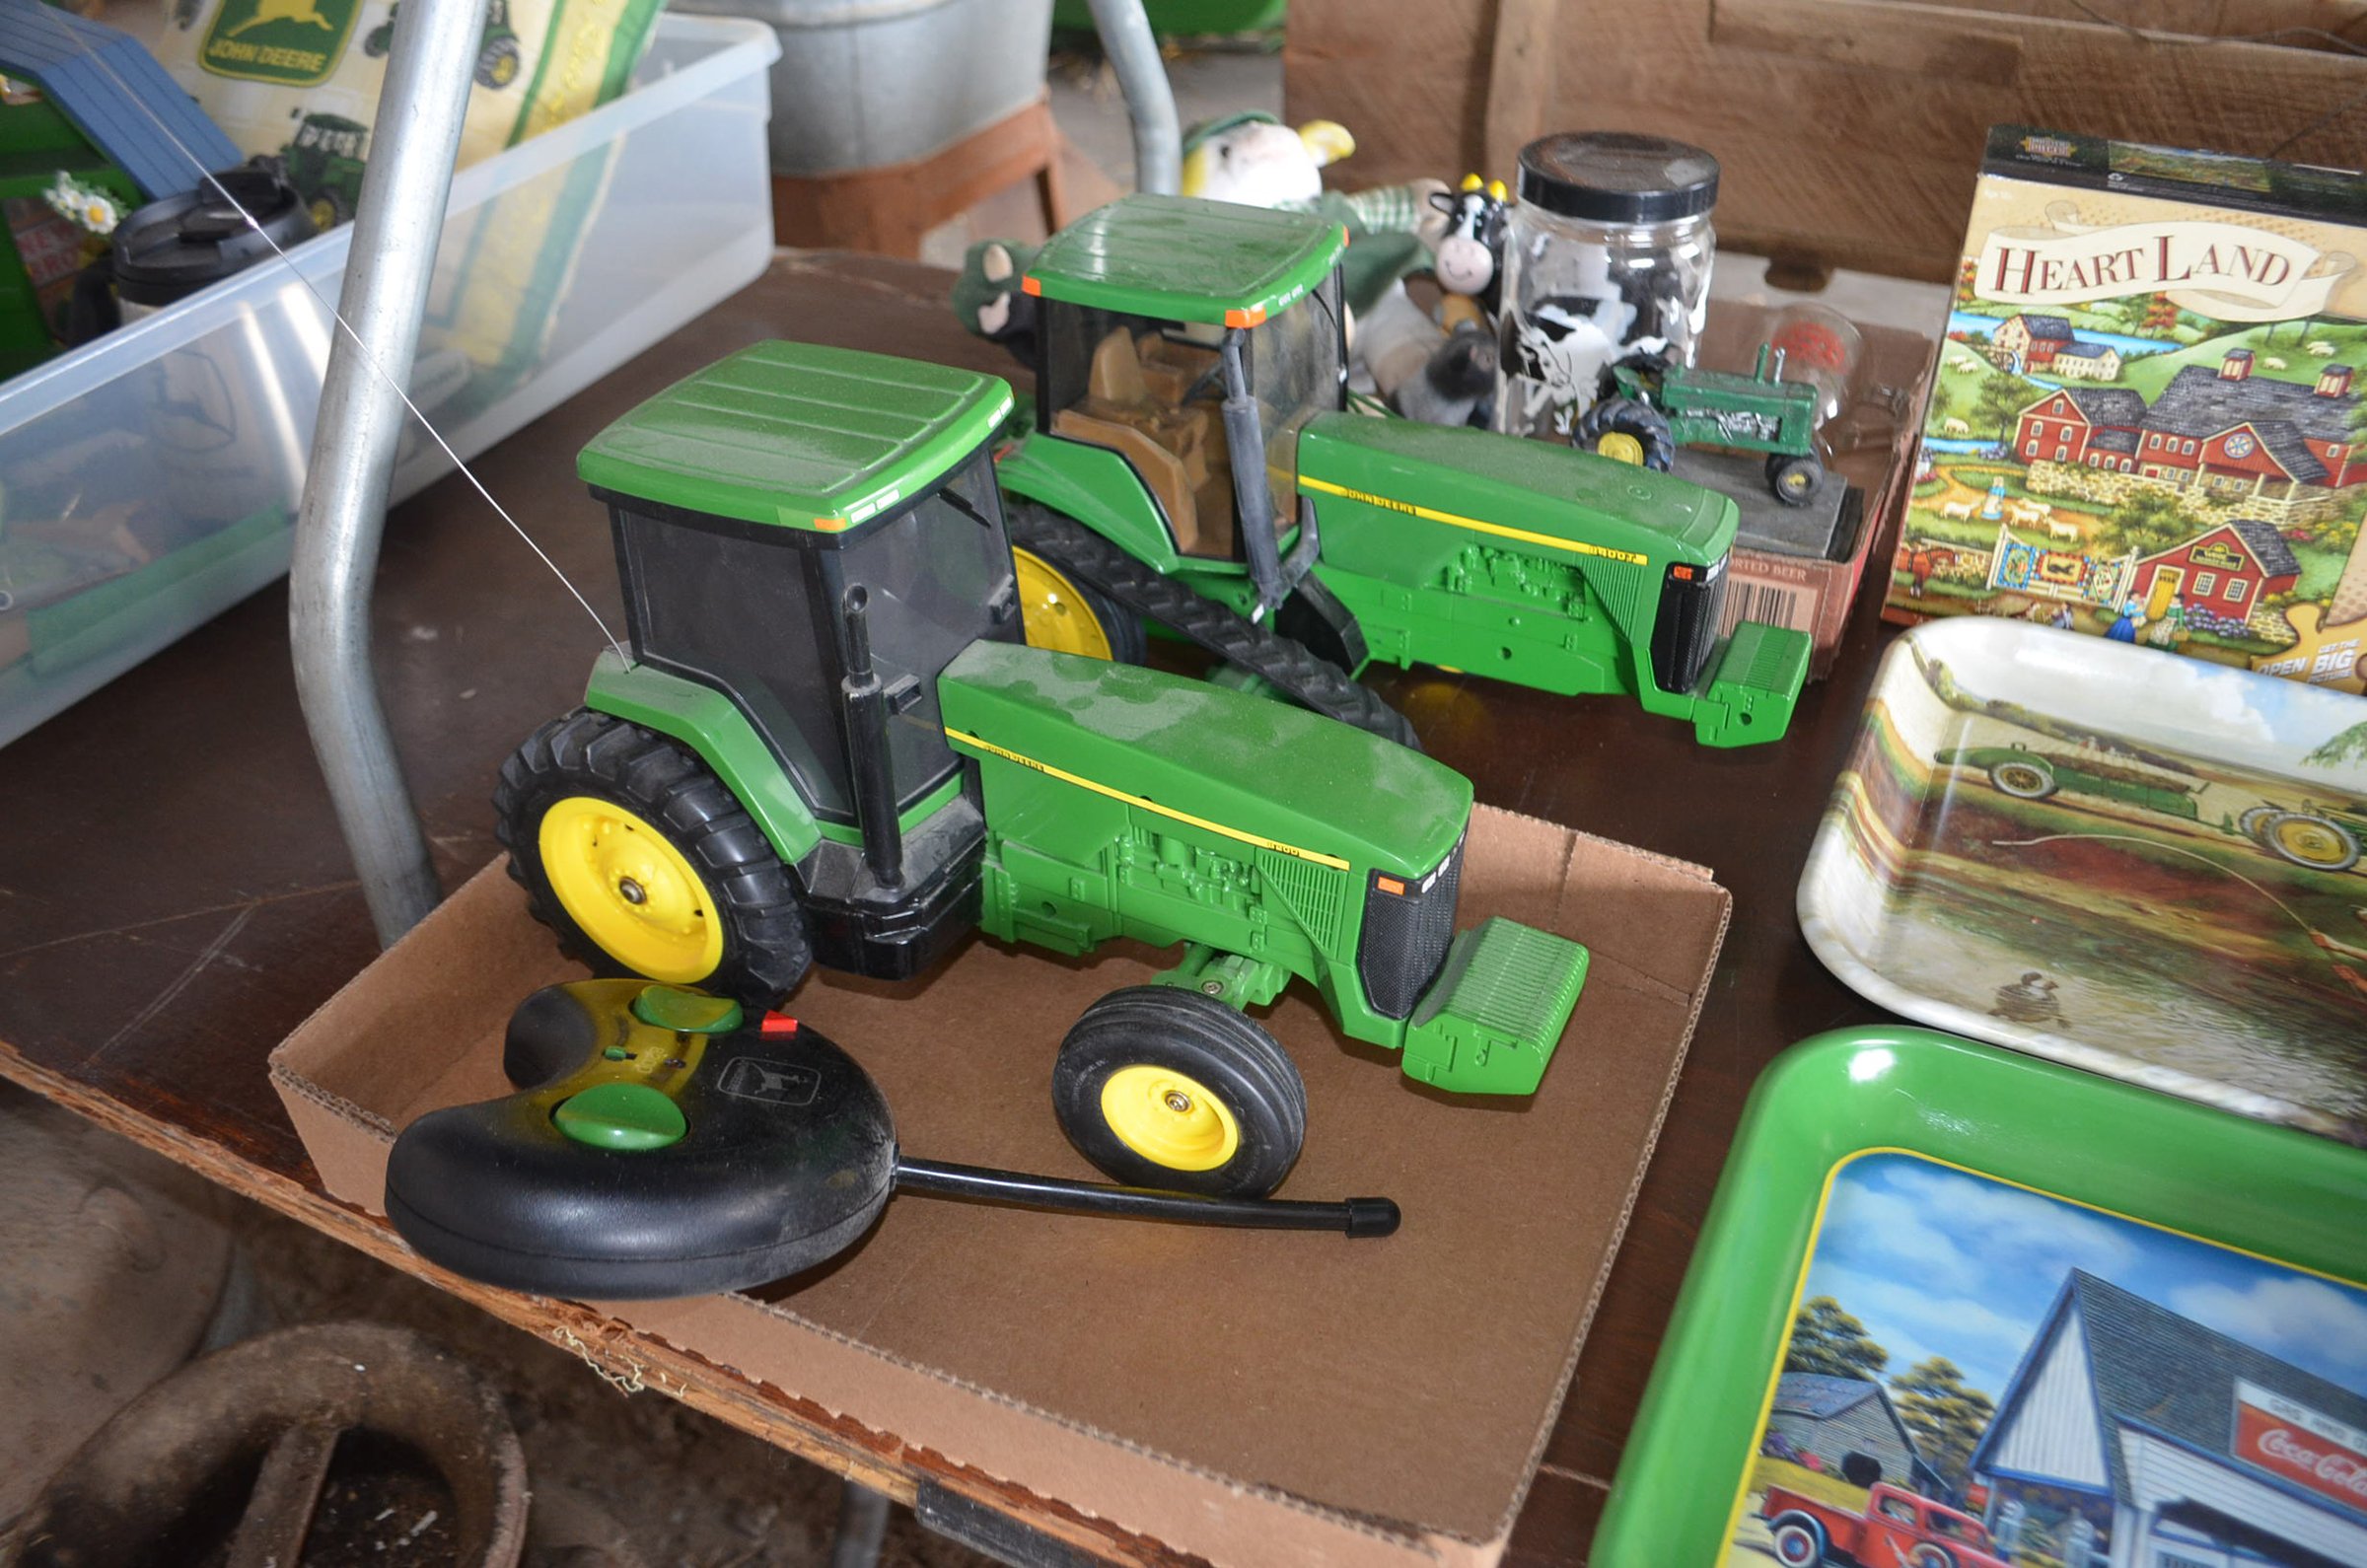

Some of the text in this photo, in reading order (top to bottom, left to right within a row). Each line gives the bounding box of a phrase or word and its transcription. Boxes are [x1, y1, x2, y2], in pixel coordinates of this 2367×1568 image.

[207, 38, 327, 73] JOHN DEERE
[1988, 235, 2290, 295] HEART LAND
[1772, 562, 1808, 583] BEER
[2257, 650, 2355, 677] OPEN BIG
